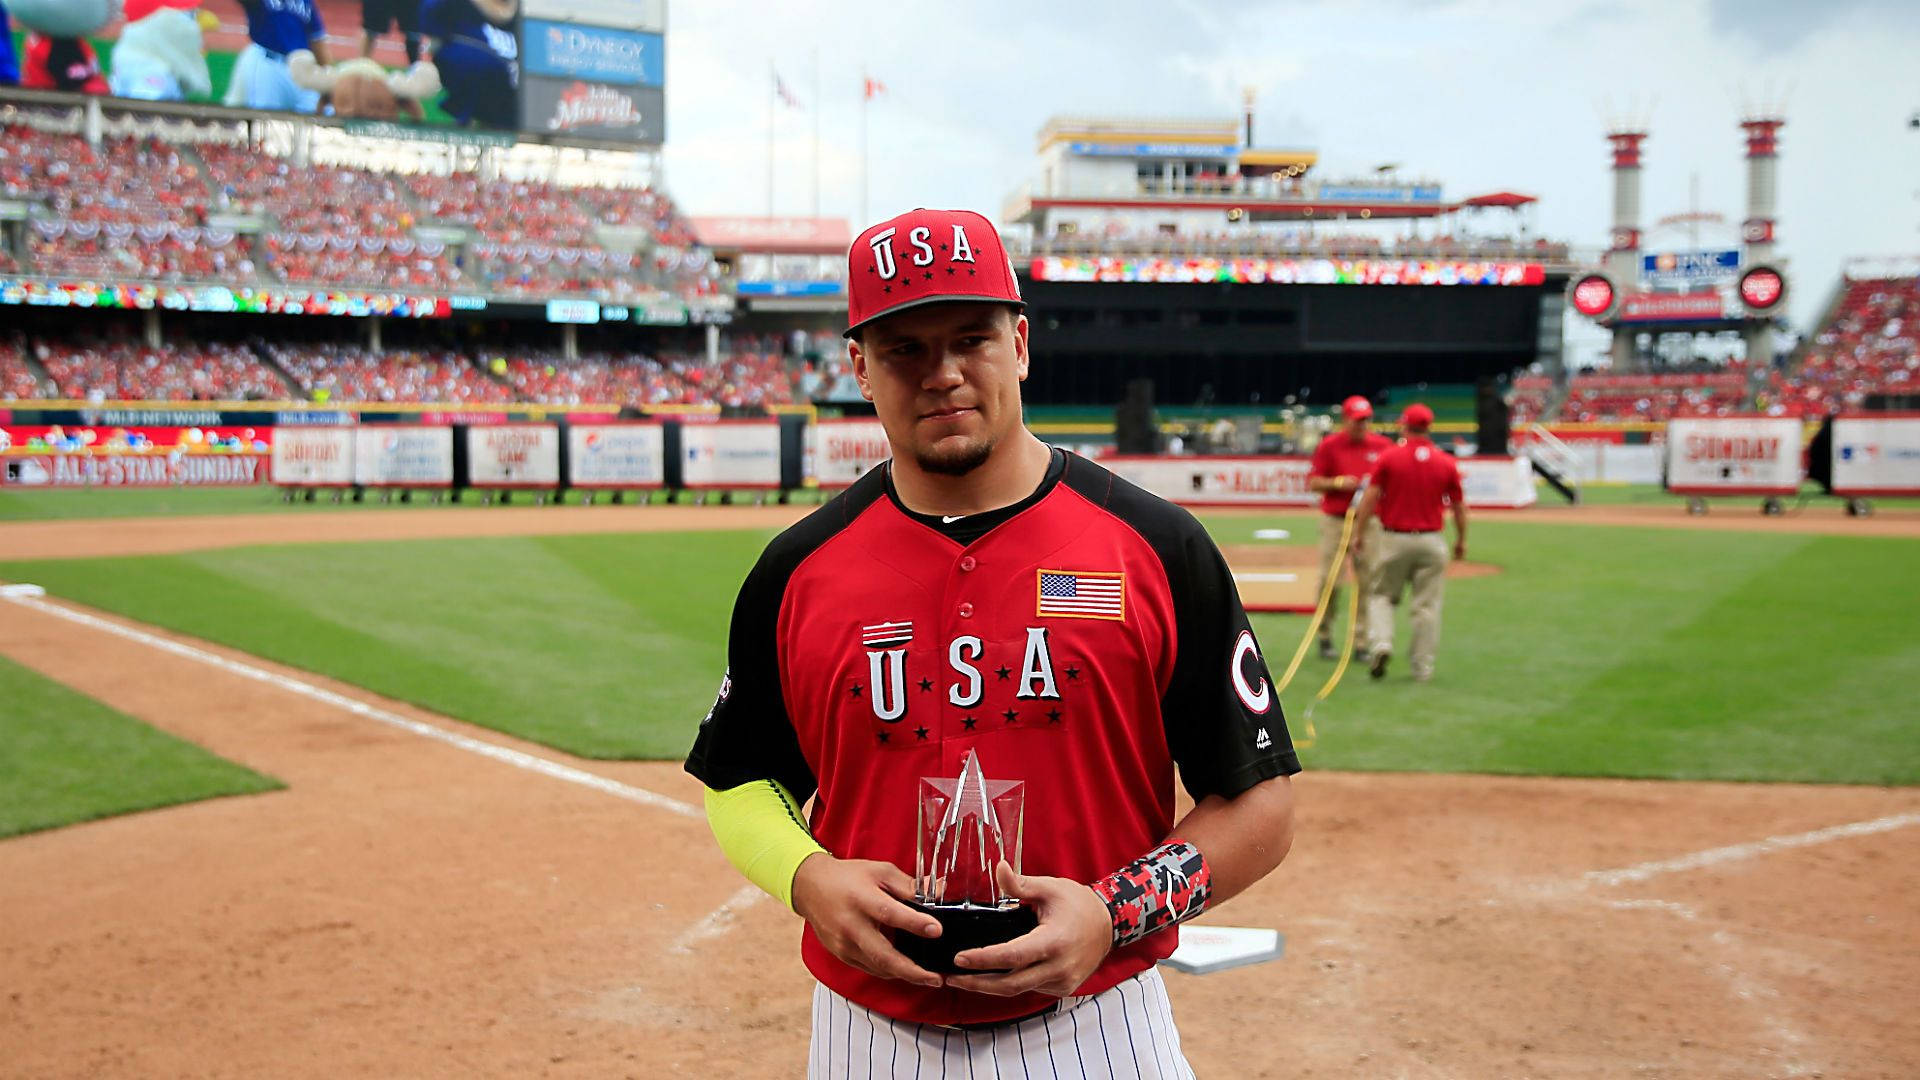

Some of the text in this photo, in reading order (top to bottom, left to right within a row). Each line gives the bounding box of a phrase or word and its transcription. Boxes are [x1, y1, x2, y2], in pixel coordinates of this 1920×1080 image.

[869, 224, 976, 281] USA
[180, 455, 258, 484] SUNDAY
[1685, 435, 1779, 461] SUNDAY
[866, 626, 1061, 723] USA
[1230, 629, 1272, 715] C
